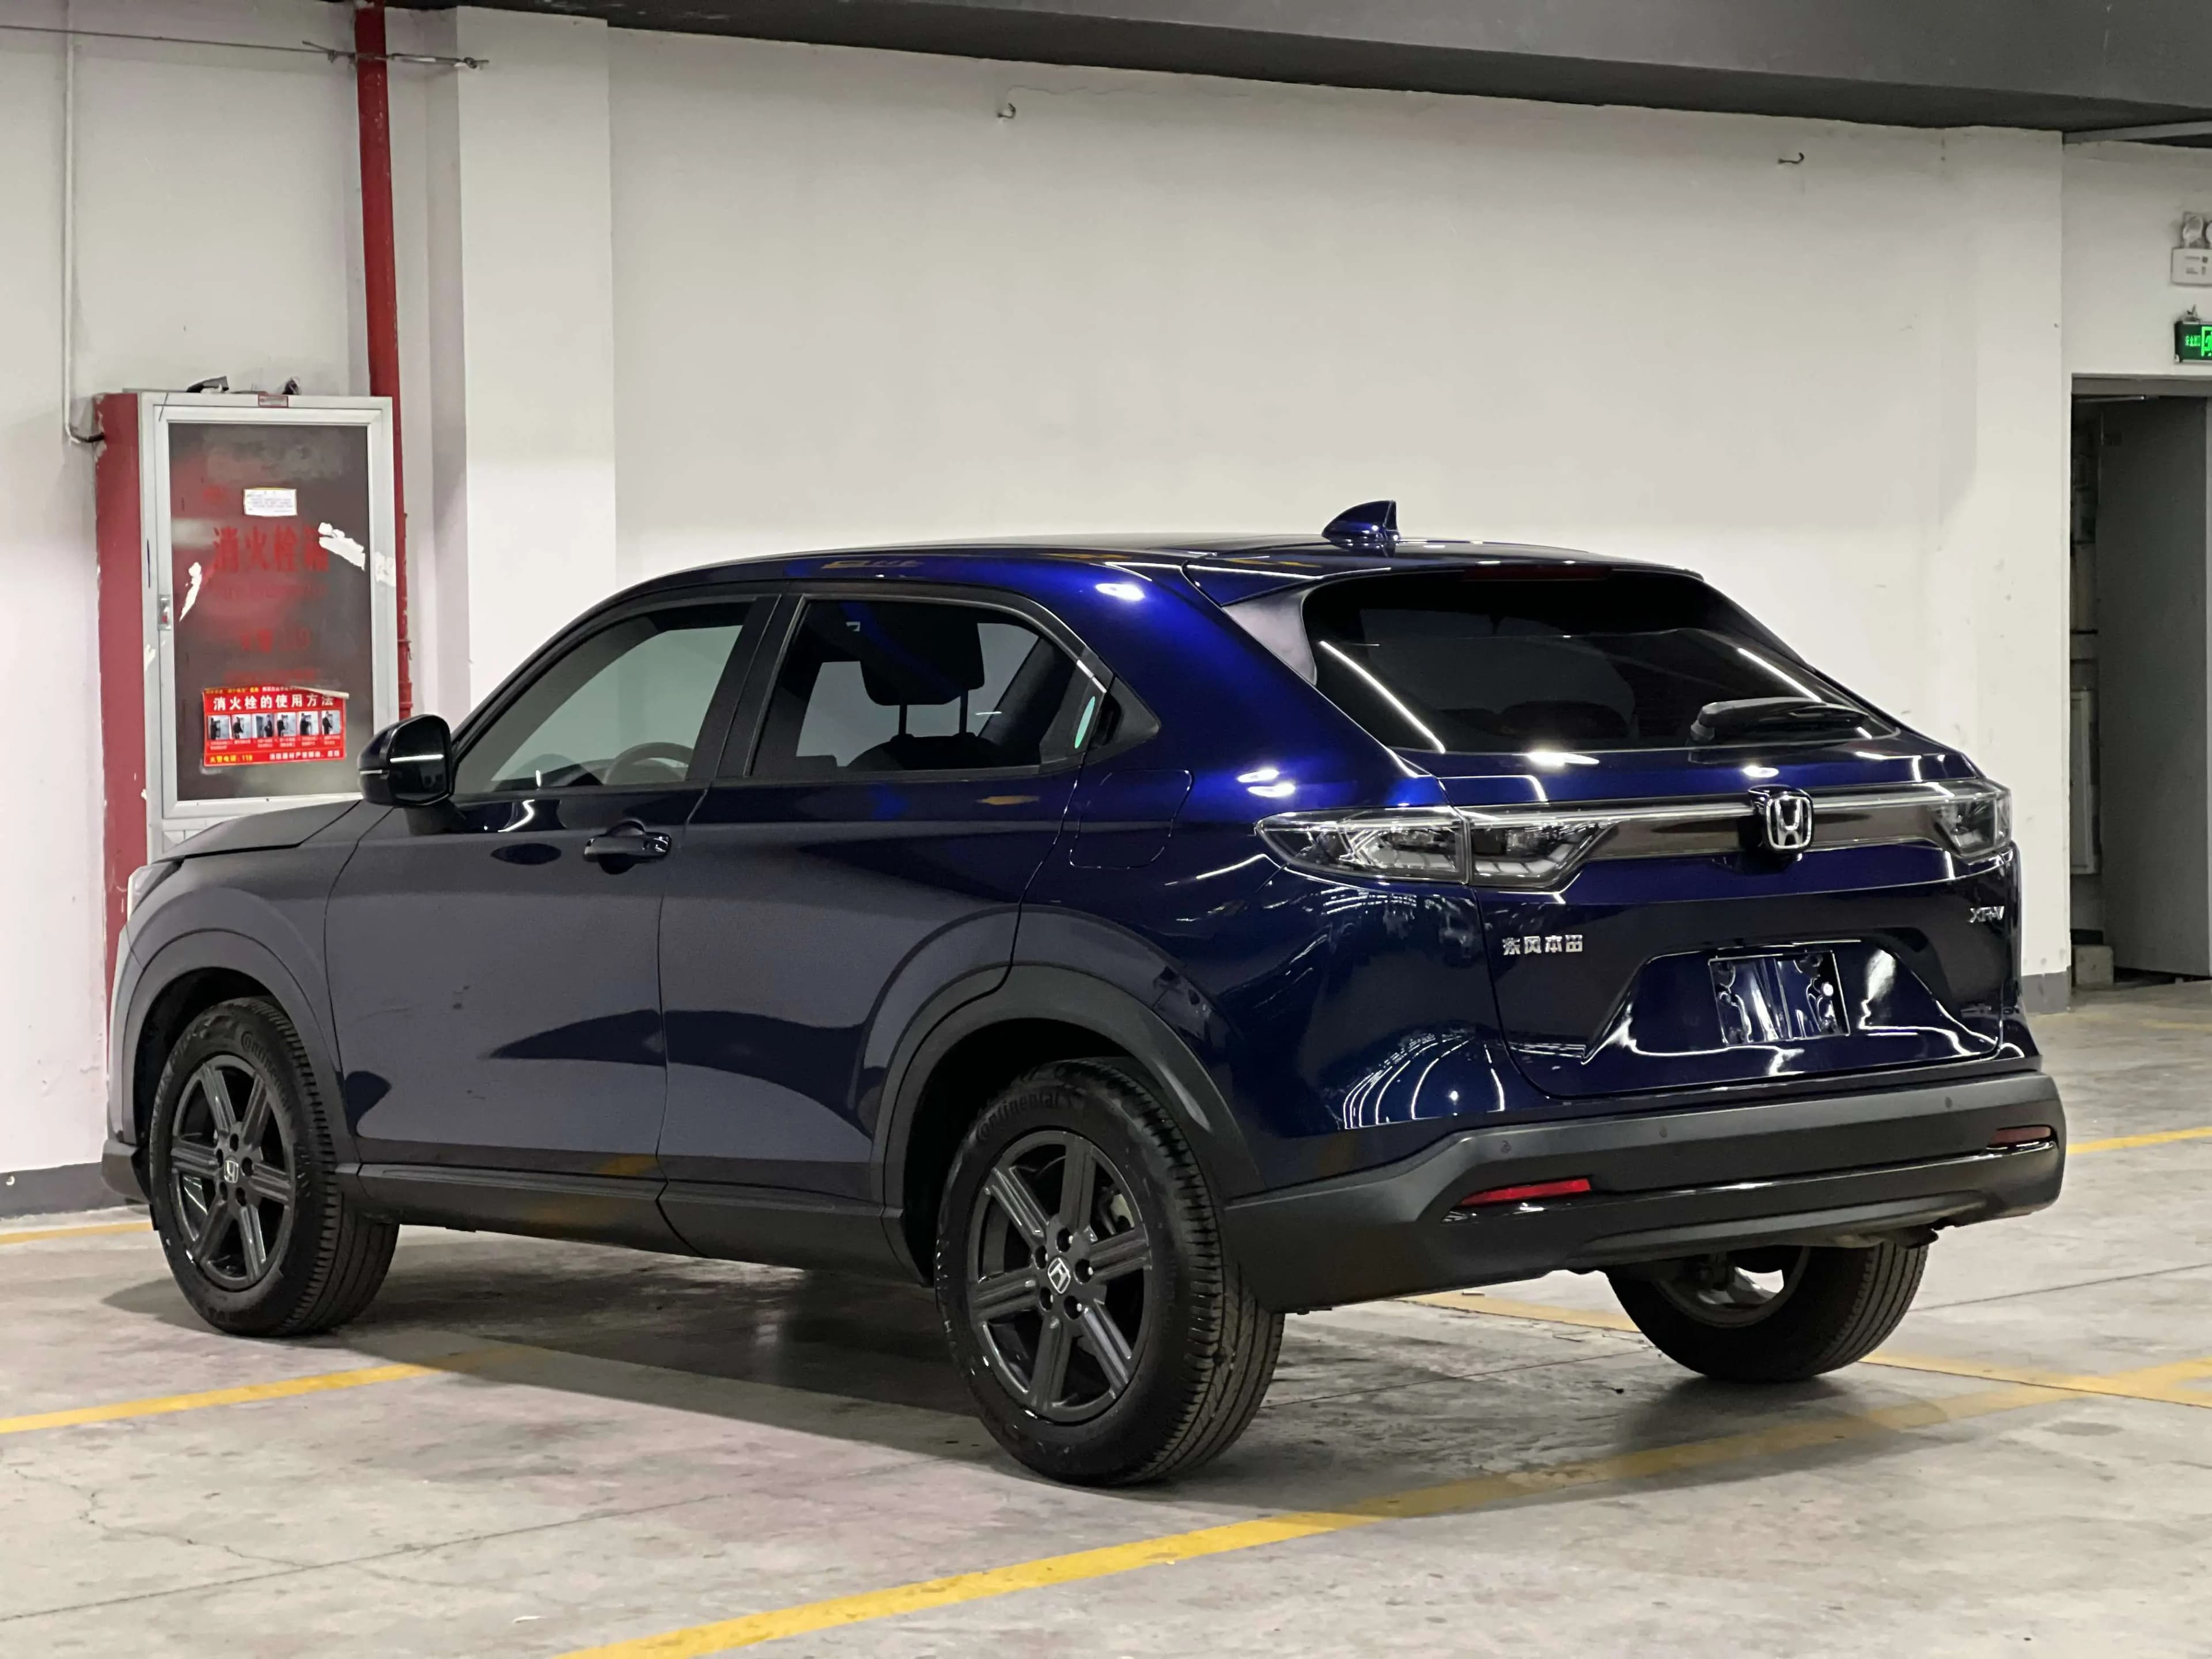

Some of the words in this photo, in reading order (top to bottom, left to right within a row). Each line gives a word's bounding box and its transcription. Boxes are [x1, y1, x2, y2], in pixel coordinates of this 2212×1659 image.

[213, 694, 334, 711] 消火栓的使用方法
[1502, 934, 1583, 956] 东风本田
